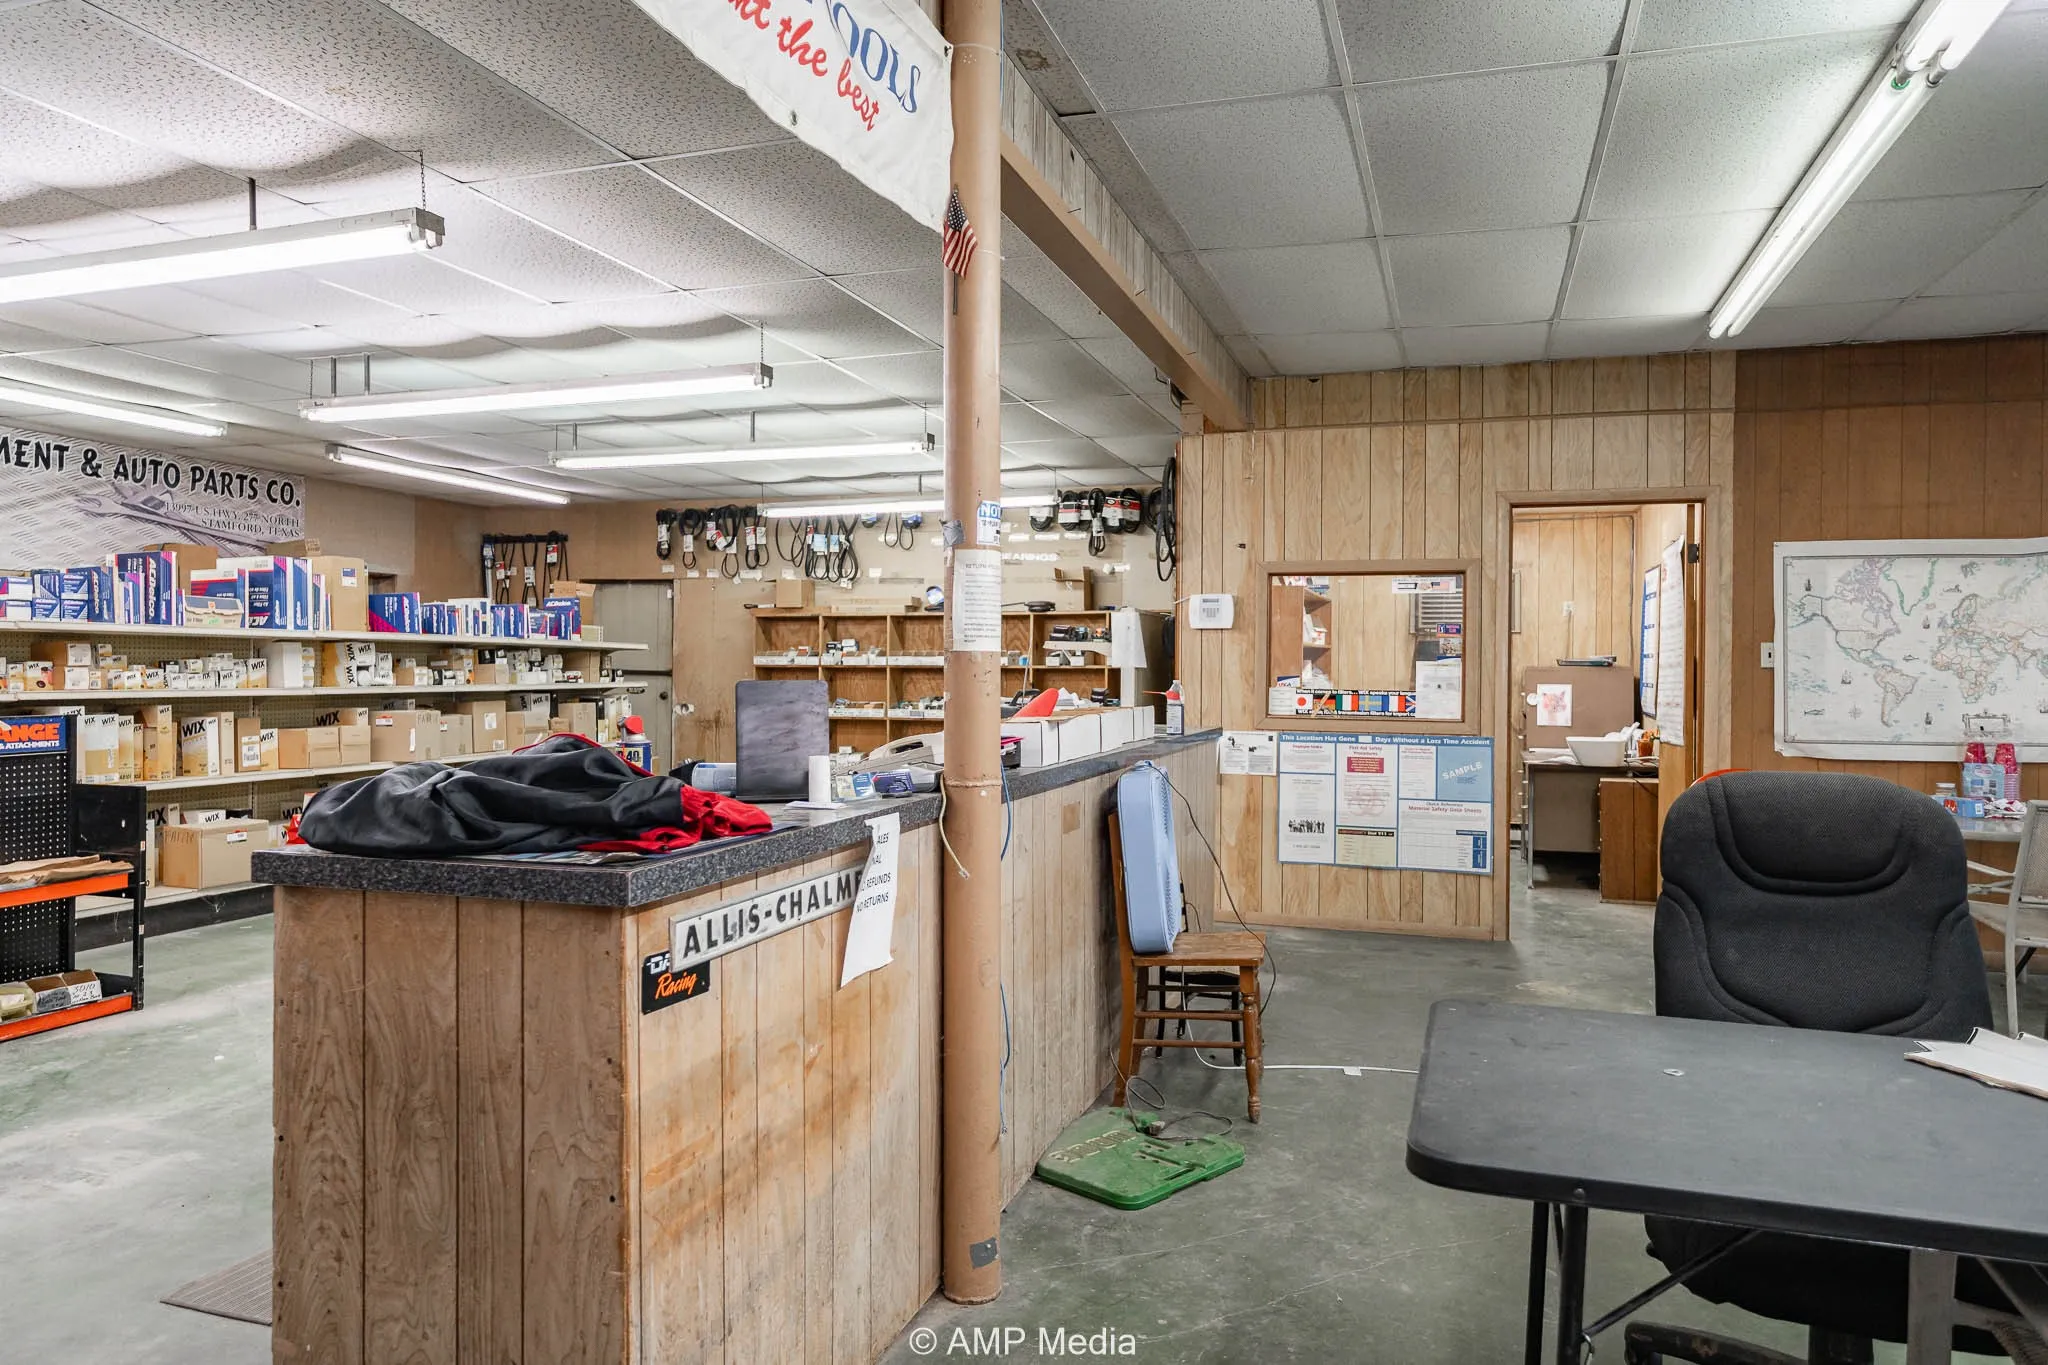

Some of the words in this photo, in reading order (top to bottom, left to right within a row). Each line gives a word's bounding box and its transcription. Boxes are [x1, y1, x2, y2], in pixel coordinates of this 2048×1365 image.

[777, 16, 828, 77] the
[837, 58, 880, 132] best
[81, 448, 102, 478] &
[113, 454, 180, 488] AUTO
[190, 465, 259, 500] PARTS
[266, 479, 300, 507] CO.
[262, 514, 300, 528] NORTH
[268, 526, 300, 537] TEXAS
[346, 643, 356, 661] WIX
[358, 644, 371, 654] WIX
[251, 661, 265, 671] WIX
[222, 672, 233, 680] WIX
[346, 665, 356, 684] WIX
[101, 717, 115, 725] WIX
[118, 719, 132, 728] WIX
[316, 710, 340, 727] WIX
[182, 720, 206, 738] WIX
[260, 730, 274, 742] WIX
[5, 741, 60, 750] ATTACHMENTS
[1442, 761, 1482, 780] SAMPLE
[205, 812, 220, 824] WIX
[867, 872, 891, 888] REFUNDS
[864, 892, 889, 908] RETURNS
[655, 971, 697, 1000] Racing
